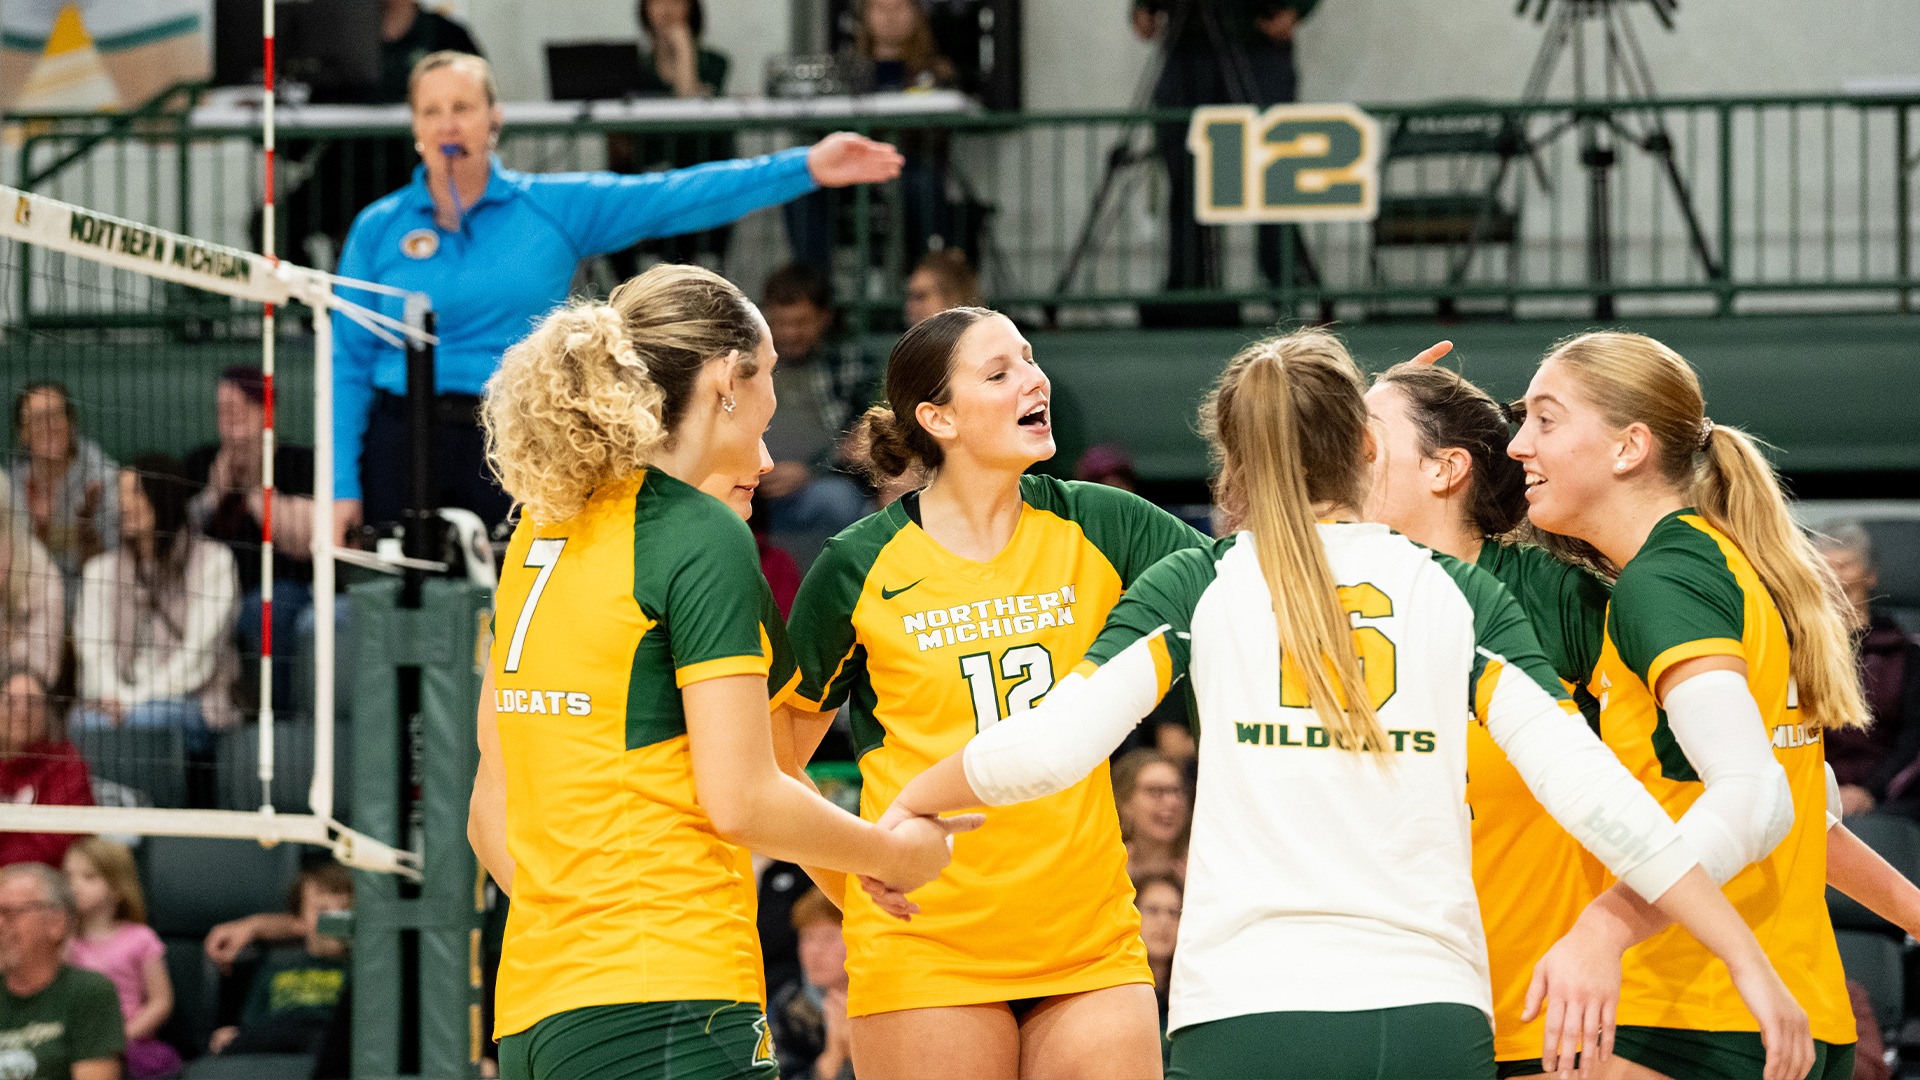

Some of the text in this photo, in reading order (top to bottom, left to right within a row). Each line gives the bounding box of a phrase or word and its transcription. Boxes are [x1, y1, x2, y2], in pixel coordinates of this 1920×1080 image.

[1199, 114, 1371, 214] 12
[71, 211, 250, 281] NORTHERN MICHIGAN
[503, 537, 569, 674] 7
[901, 584, 1077, 634] NORTHERN
[915, 606, 1075, 651] MICHIGAN
[959, 642, 1056, 735] 12
